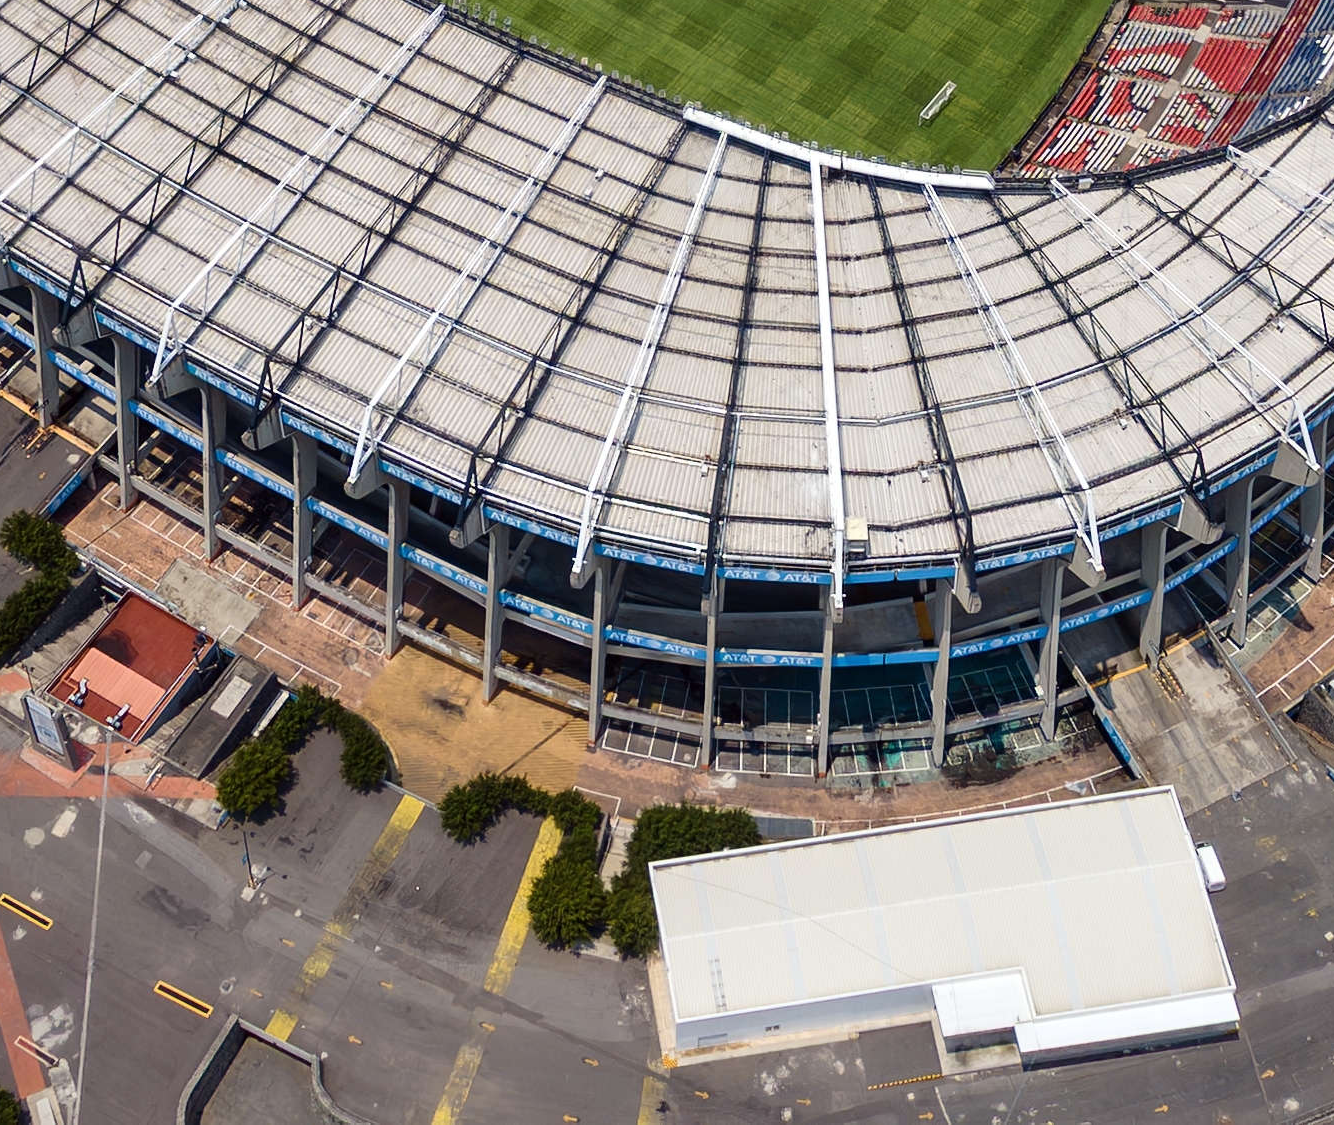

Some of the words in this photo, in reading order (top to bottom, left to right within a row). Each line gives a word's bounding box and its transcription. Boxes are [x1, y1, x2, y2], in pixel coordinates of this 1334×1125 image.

[102, 317, 128, 336] AT&T
[55, 353, 77, 375] AT&T
[94, 381, 116, 401] AT&T
[194, 369, 222, 389] AT&T
[136, 407, 163, 427] AT&T
[177, 430, 203, 449] AT&T
[287, 418, 316, 438] AT&T
[224, 456, 250, 475] AT&T
[267, 480, 294, 498] AT&T
[386, 466, 417, 485] AT&T
[1242, 458, 1269, 477] AT&T
[313, 504, 341, 523] AT&T
[358, 527, 386, 546] AT&T
[490, 511, 523, 528] AT&T
[544, 530, 578, 546] AT&T
[1141, 508, 1174, 525] AT&T
[603, 548, 638, 562] AT&T
[660, 560, 696, 574] AT&T
[975, 559, 1008, 572] AT&T
[1029, 547, 1065, 560] AT&T
[1204, 544, 1231, 565] AT&T
[407, 551, 436, 570] AT&T
[455, 573, 485, 591] AT&T
[724, 569, 761, 580] AT&T
[783, 573, 820, 584] AT&T
[505, 595, 537, 613] AT&T
[556, 615, 589, 632] AT&T
[1061, 614, 1093, 631] AT&T
[1111, 596, 1144, 613] AT&T
[610, 631, 644, 645] AT&T
[664, 642, 699, 657] AT&T
[952, 643, 985, 658] AT&T
[1006, 630, 1039, 645] AT&T
[722, 653, 757, 663] AT&T
[779, 655, 814, 665] AT&T
